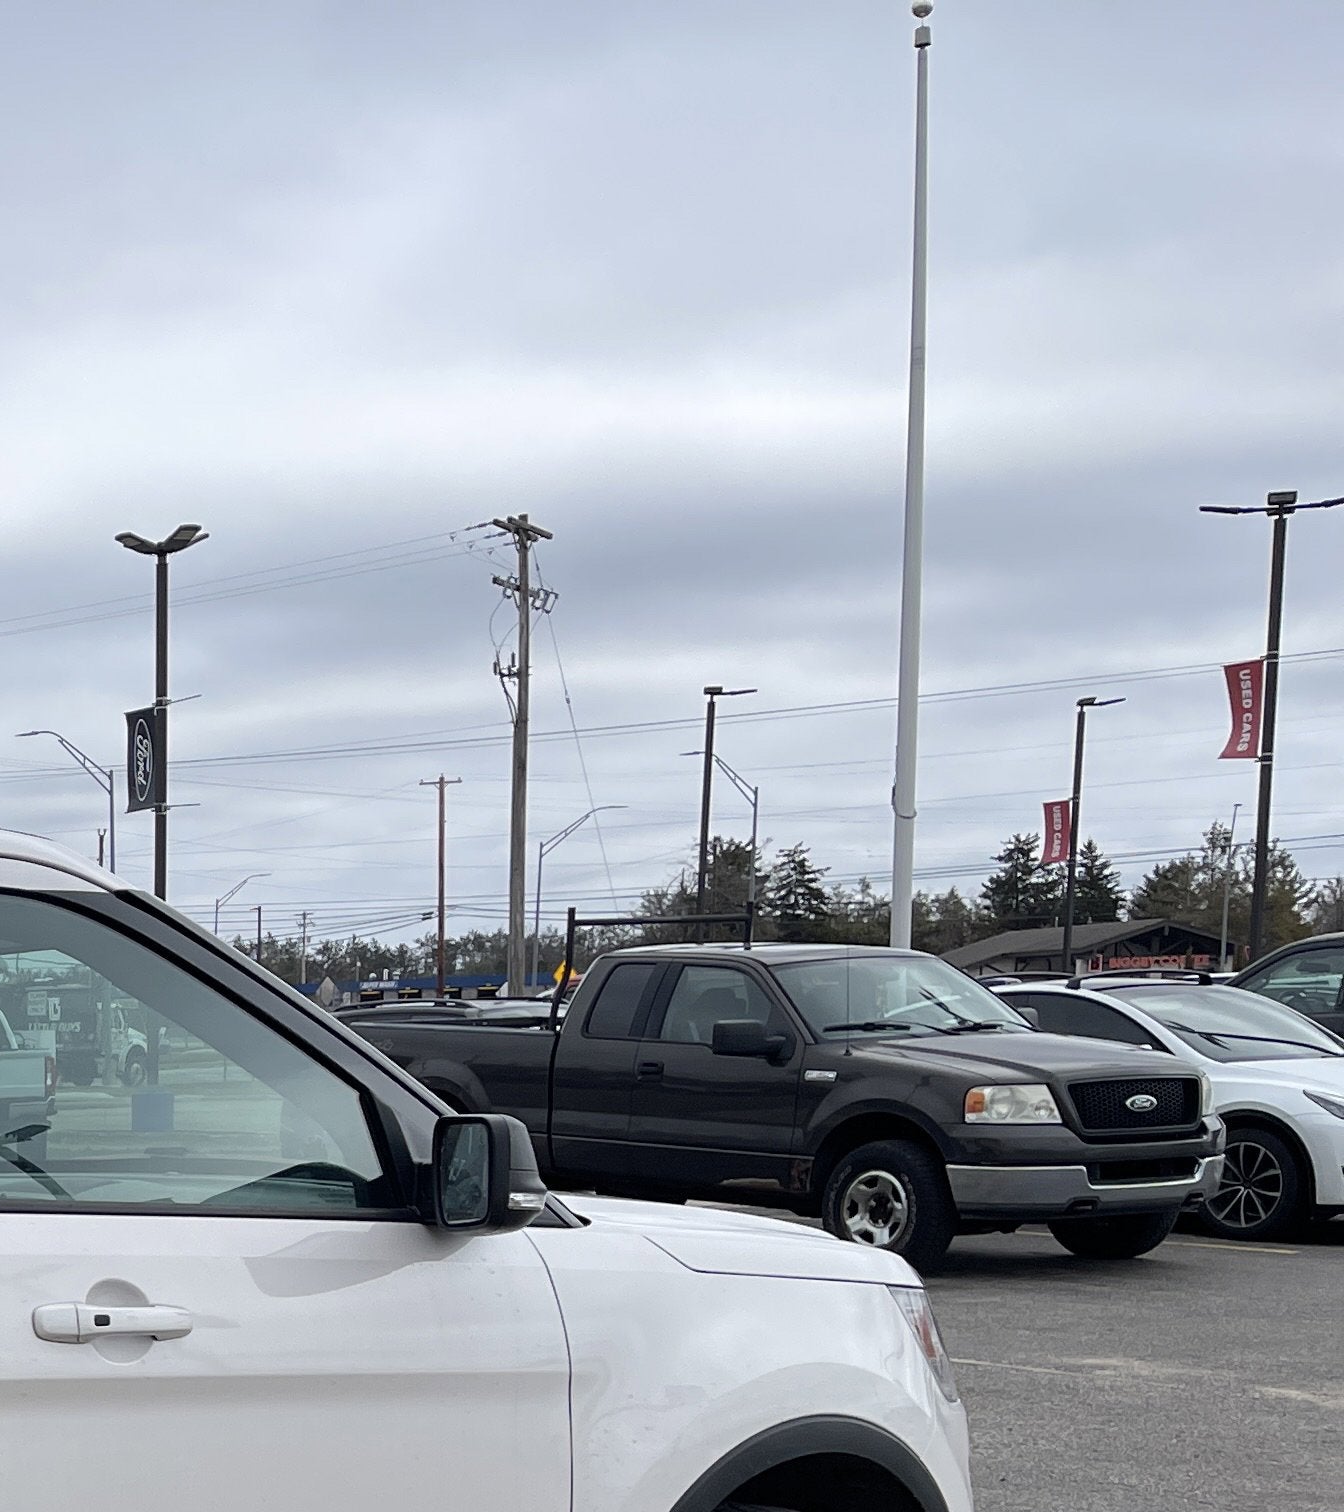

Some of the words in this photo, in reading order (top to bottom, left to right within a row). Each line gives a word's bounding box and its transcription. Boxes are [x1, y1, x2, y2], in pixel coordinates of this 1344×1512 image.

[1238, 668, 1253, 709] USED
[1236, 712, 1253, 752] CARS
[1052, 805, 1062, 831] USED
[1050, 832, 1062, 858] CARS
